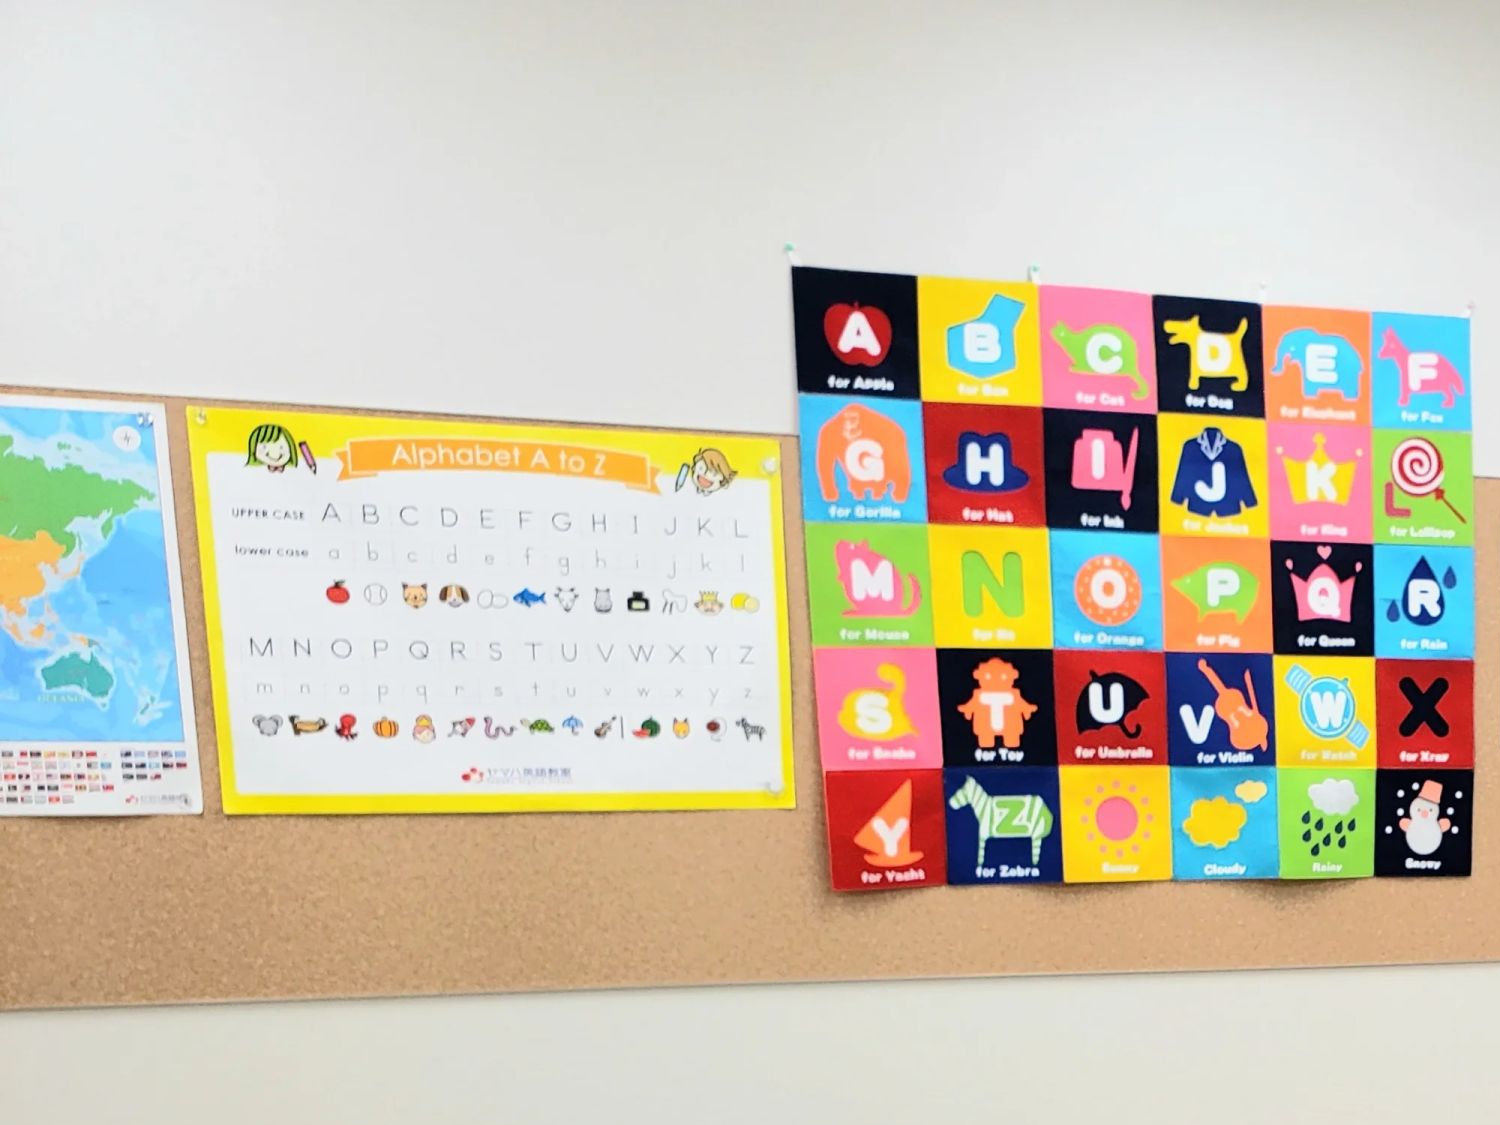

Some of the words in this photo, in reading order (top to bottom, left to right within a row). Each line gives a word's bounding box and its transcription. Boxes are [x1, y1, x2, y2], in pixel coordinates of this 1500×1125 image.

[838, 311, 881, 356] A
[964, 322, 1001, 363] B
[1086, 333, 1123, 374] C
[1197, 333, 1232, 373] D
[1306, 344, 1338, 384] E
[827, 375, 850, 389] for
[853, 376, 894, 392] Apple
[1408, 353, 1438, 391] F
[958, 383, 978, 395] for
[1076, 392, 1096, 404] for
[1185, 394, 1206, 407] for
[1207, 395, 1233, 410] Dog
[1280, 406, 1299, 417] for
[1401, 411, 1419, 422] for
[392, 443, 519, 469] Alphabet
[530, 449, 550, 468] A
[560, 452, 585, 471] to
[593, 454, 607, 474] Z
[845, 439, 884, 481] G
[966, 442, 1004, 486] H
[1092, 438, 1105, 480] I
[1195, 462, 1226, 502] J
[1306, 460, 1337, 501] K
[829, 504, 851, 518] for
[854, 505, 901, 519] Gorilla
[1385, 482, 1411, 518] L
[232, 508, 268, 519] UPPER
[272, 509, 304, 520] CASE
[321, 503, 341, 522] A
[362, 504, 380, 525] B
[400, 506, 419, 526] C
[441, 508, 459, 527] D
[480, 509, 495, 529] E
[519, 511, 532, 530] F
[552, 512, 572, 531] G
[592, 514, 607, 532] H
[632, 515, 638, 534] I
[664, 517, 677, 536] J
[698, 518, 713, 537] K
[735, 520, 748, 539] L
[962, 507, 985, 521] for
[1080, 513, 1101, 527] for
[1301, 524, 1318, 535] for
[1390, 526, 1407, 537] for
[1409, 526, 1456, 539] Lollipop
[235, 544, 271, 556] lower
[277, 547, 309, 558] case
[329, 548, 340, 560] a
[367, 541, 379, 561] b
[407, 551, 417, 562] c
[447, 545, 458, 564] d
[485, 553, 494, 565] e
[524, 548, 533, 566] f
[559, 557, 570, 577] g
[595, 550, 607, 568] h
[634, 553, 639, 569] i
[668, 554, 676, 578] j
[701, 554, 713, 572] k
[740, 554, 744, 572] l
[851, 558, 894, 601] M
[962, 550, 1024, 618] N
[1090, 569, 1126, 609] O
[1207, 568, 1240, 607] P
[1307, 577, 1340, 618] Q
[1408, 578, 1441, 617] R
[840, 628, 862, 640] for
[865, 629, 909, 640] Mouse
[972, 628, 992, 640] for
[1074, 631, 1094, 644] for
[1097, 632, 1144, 647] Orange
[1197, 634, 1217, 645] for
[1219, 635, 1240, 648] Pig
[1298, 635, 1317, 647] for
[1319, 636, 1355, 647] Queen
[1400, 639, 1419, 650] for
[1421, 639, 1448, 650] Rain
[250, 637, 273, 657] M
[293, 638, 311, 657] N
[331, 639, 352, 658] O
[373, 640, 388, 658] P
[409, 641, 429, 660] Q
[450, 641, 467, 660] R
[489, 642, 502, 661] S
[524, 642, 543, 661] T
[561, 643, 577, 662] U
[597, 644, 614, 663] V
[628, 644, 654, 663] W
[668, 645, 685, 663] X
[706, 646, 718, 663] Y
[740, 646, 755, 664] Z
[257, 682, 273, 694] m
[300, 683, 311, 694] n
[339, 684, 350, 695] o
[378, 684, 388, 703] p
[416, 685, 427, 704] q
[454, 685, 464, 696] r
[494, 685, 503, 697] s
[532, 681, 538, 696] t
[566, 687, 576, 697] u
[604, 687, 612, 696] v
[638, 687, 649, 697] w
[674, 687, 683, 697] x
[709, 688, 718, 705] y
[744, 688, 751, 699] z
[1089, 682, 1124, 724] U
[855, 691, 893, 735] S
[979, 692, 1014, 732] T
[1310, 691, 1347, 729] W
[1399, 677, 1449, 738] X
[1180, 704, 1215, 744] V
[848, 747, 869, 760] for
[975, 748, 996, 761] for
[998, 748, 1024, 762] Toy
[1075, 746, 1096, 758] for
[1098, 747, 1153, 759] Umbrella
[1197, 752, 1217, 763] for
[1219, 753, 1254, 764] Violin
[1400, 751, 1418, 762] for
[994, 800, 1029, 834] Z
[872, 817, 908, 857] Y
[976, 866, 996, 878] for
[999, 865, 1040, 877] Zebra
[1204, 863, 1246, 876] Cloudy
[1312, 862, 1343, 873] Rainy
[1405, 858, 1442, 870] Snowy
[861, 871, 882, 884] for
